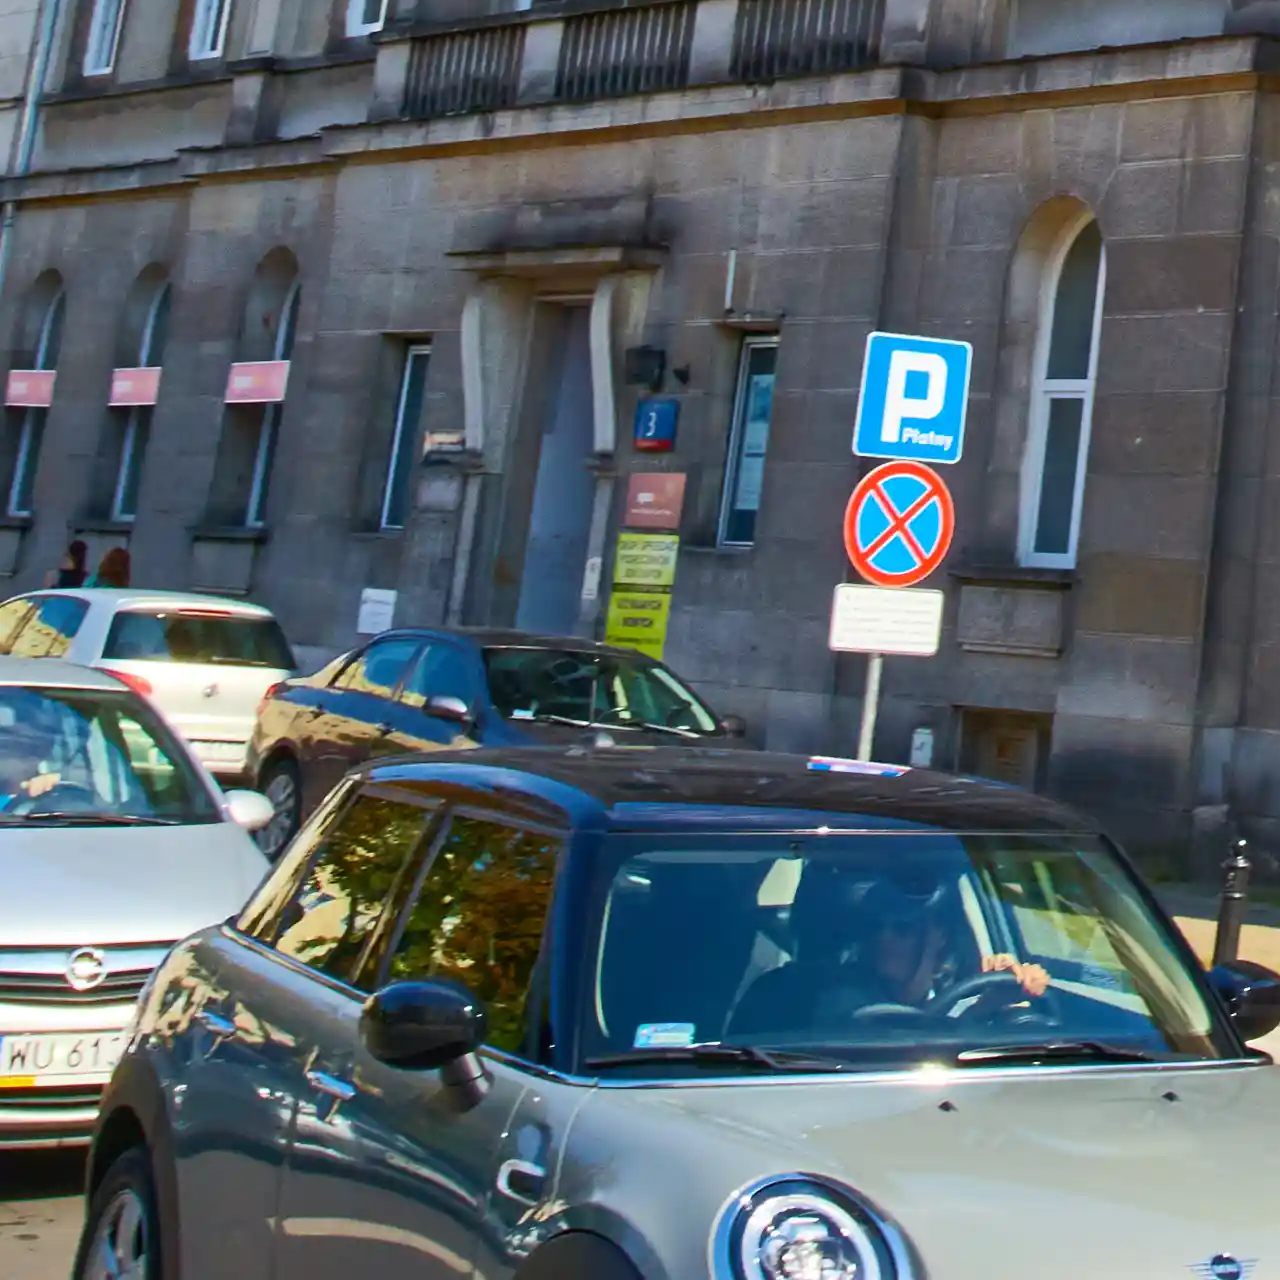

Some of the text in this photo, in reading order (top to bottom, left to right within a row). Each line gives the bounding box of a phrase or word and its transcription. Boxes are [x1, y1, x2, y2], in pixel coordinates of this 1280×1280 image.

[880, 349, 948, 443] P
[644, 411, 658, 437] 3
[8, 1040, 55, 1070] WU
